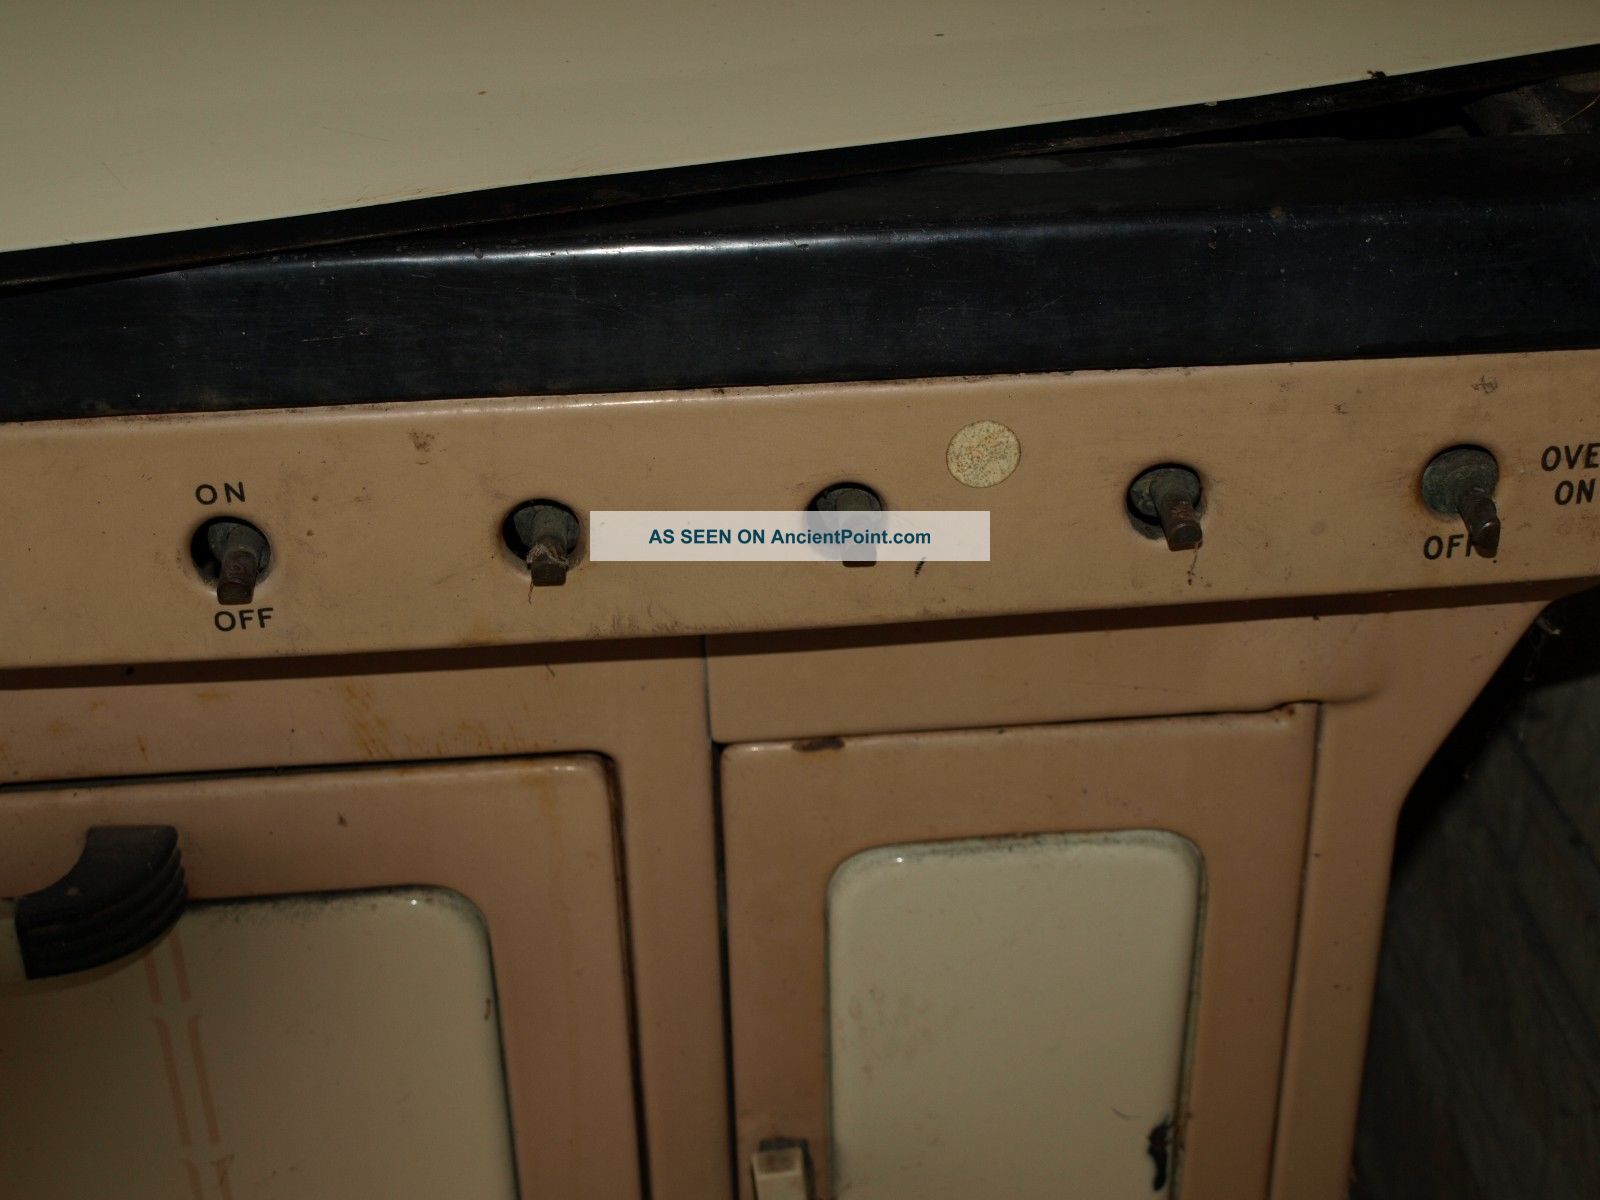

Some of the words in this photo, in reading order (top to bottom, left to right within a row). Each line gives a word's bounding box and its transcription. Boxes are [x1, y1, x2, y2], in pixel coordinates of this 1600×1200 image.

[195, 481, 246, 505] ON
[1554, 478, 1596, 505] ON
[214, 607, 274, 632] OFF
